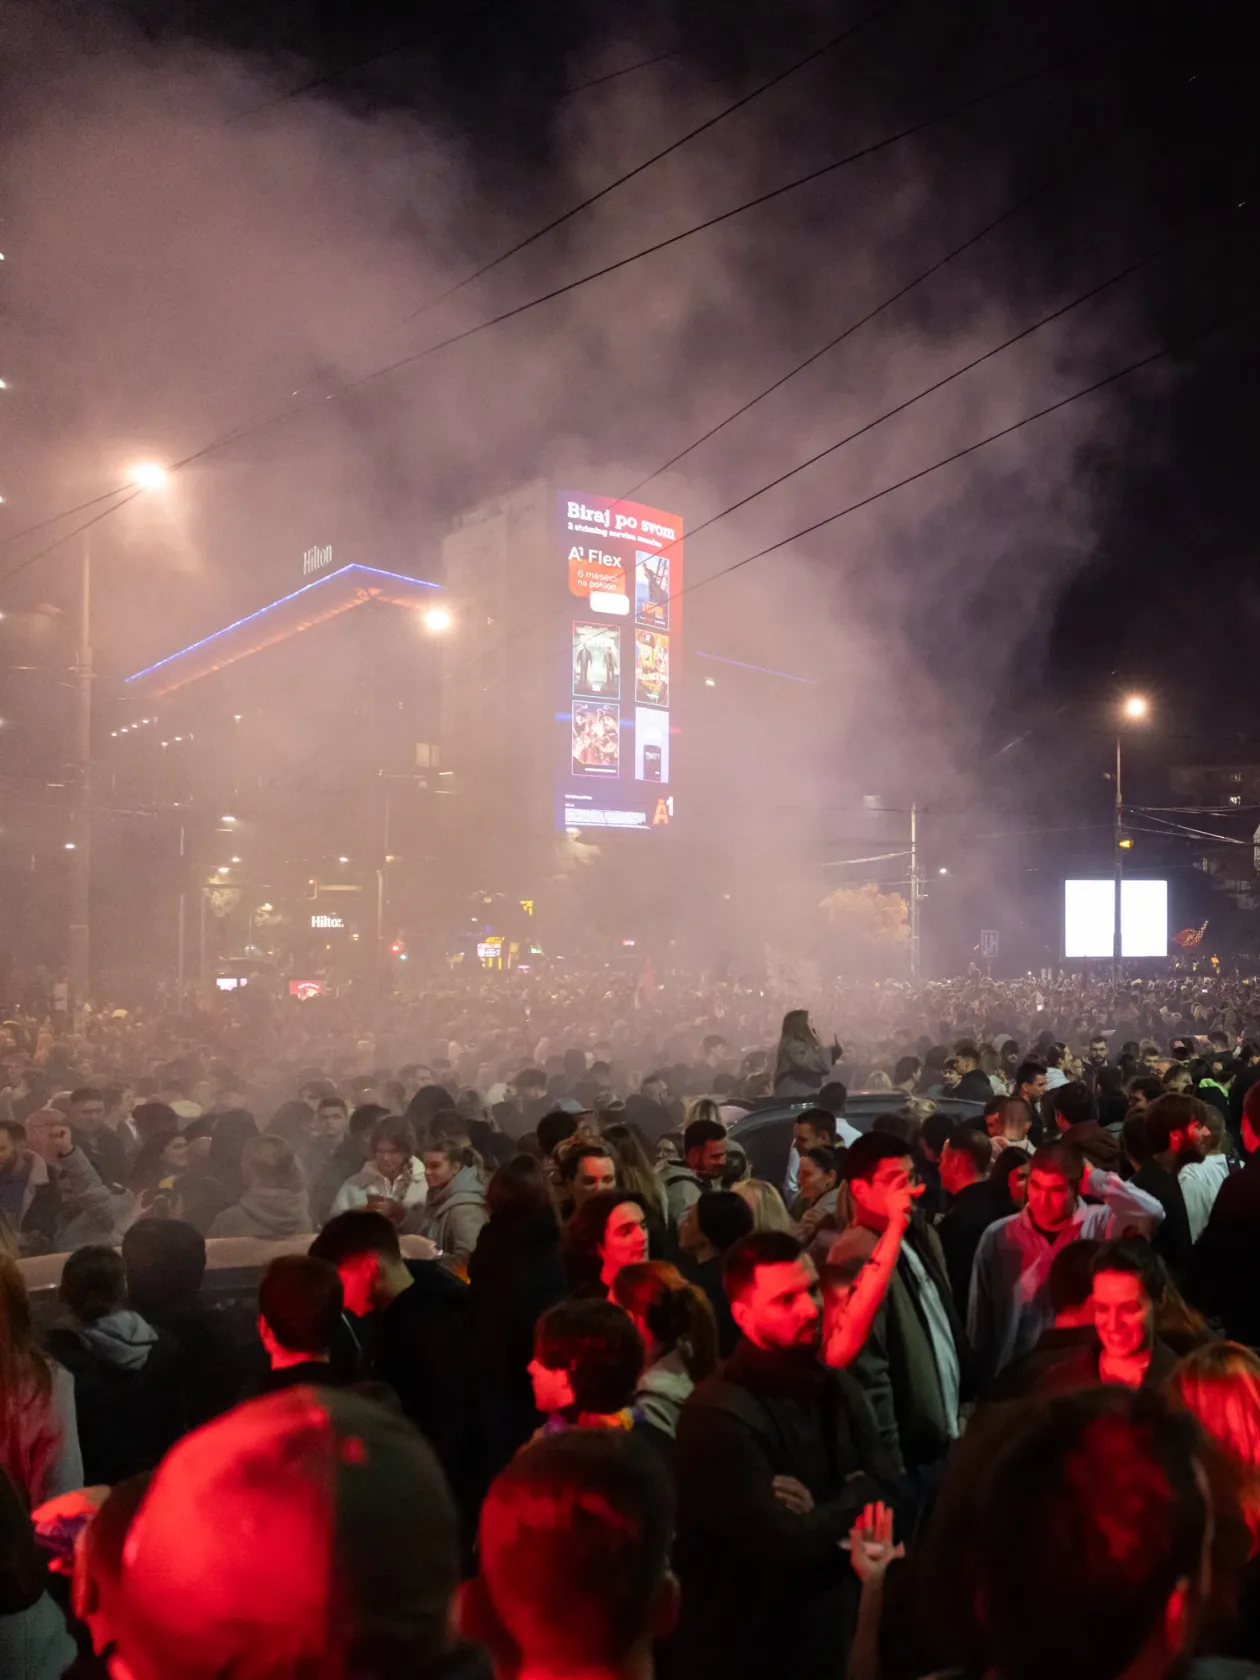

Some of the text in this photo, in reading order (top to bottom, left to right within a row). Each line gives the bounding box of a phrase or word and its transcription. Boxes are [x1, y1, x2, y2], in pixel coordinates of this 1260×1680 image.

[567, 501, 676, 541] Biraj po svom
[303, 544, 332, 576] Hilton
[588, 549, 622, 568] Flex
[577, 569, 584, 578] 6
[652, 796, 673, 825] A1
